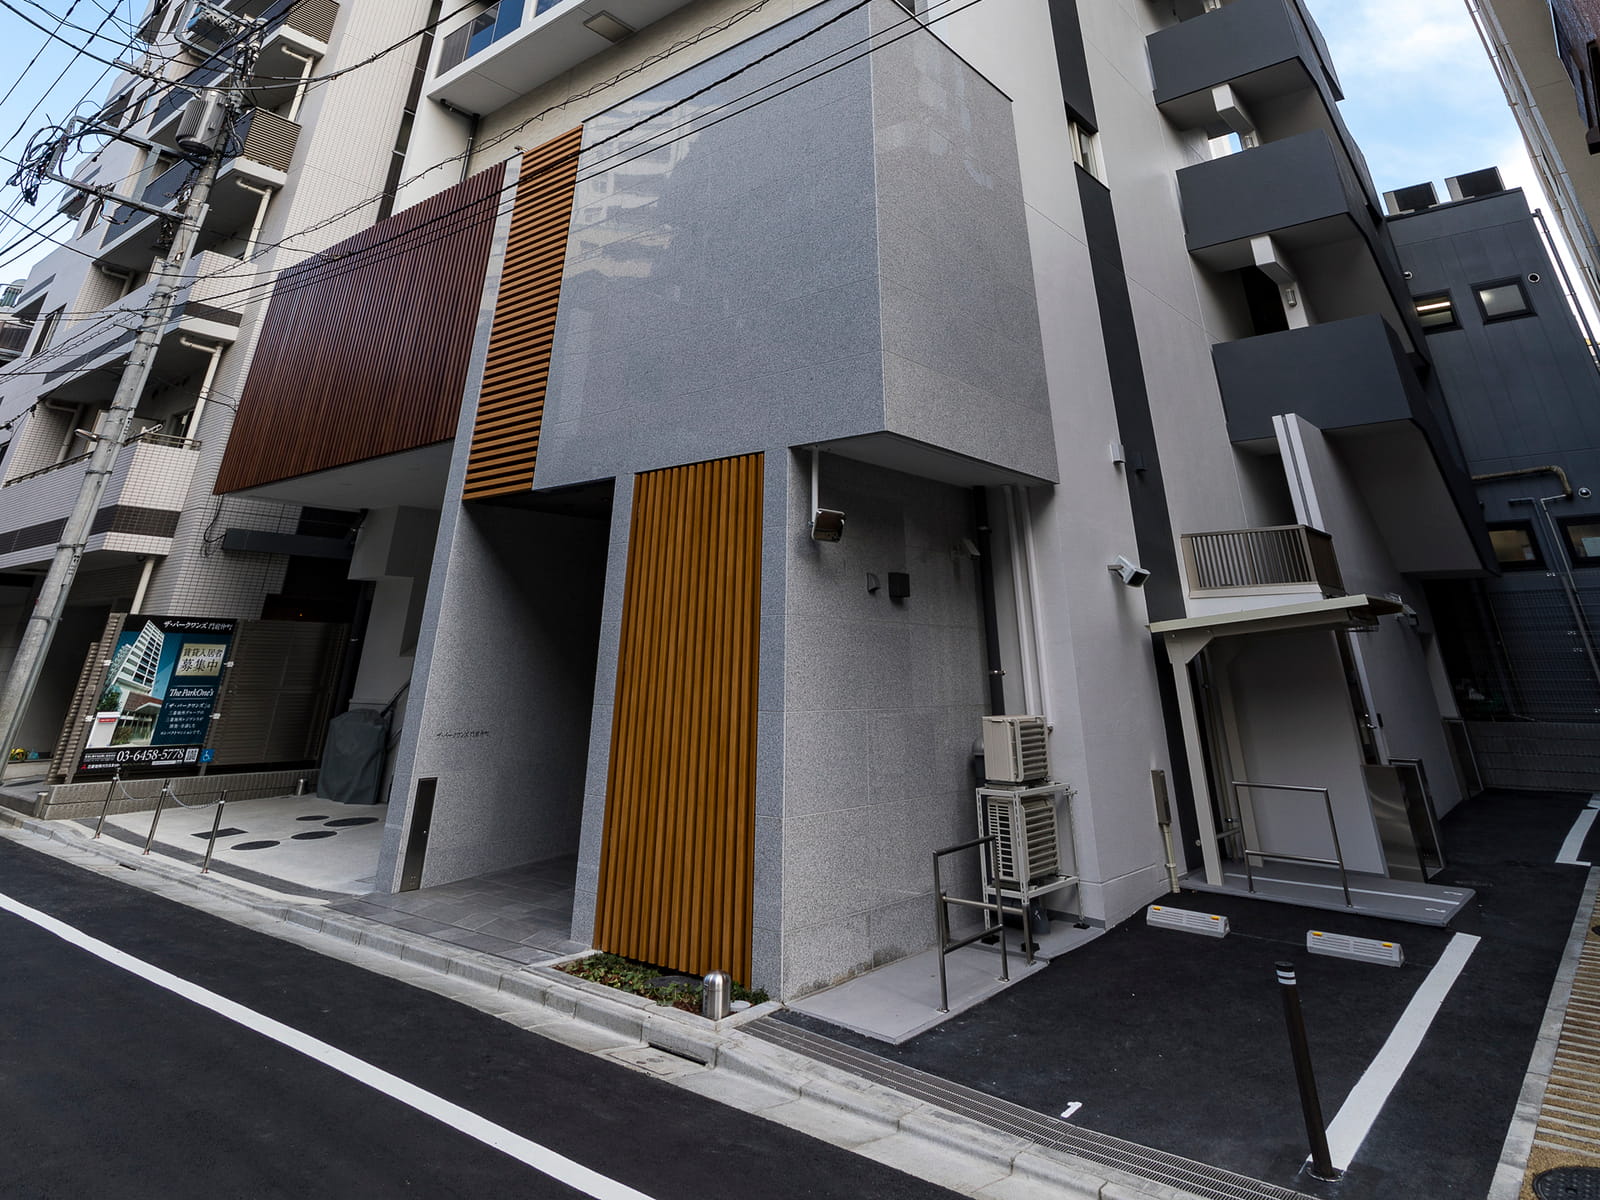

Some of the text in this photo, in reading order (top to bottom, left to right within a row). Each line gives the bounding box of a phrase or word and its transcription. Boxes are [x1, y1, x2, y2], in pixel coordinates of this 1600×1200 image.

[183, 647, 224, 658] 賃貸入居者
[181, 658, 219, 672] 募集中
[169, 688, 182, 697] The
[116, 748, 185, 762] 03-6458-5778
[1060, 1101, 1083, 1119] 1
